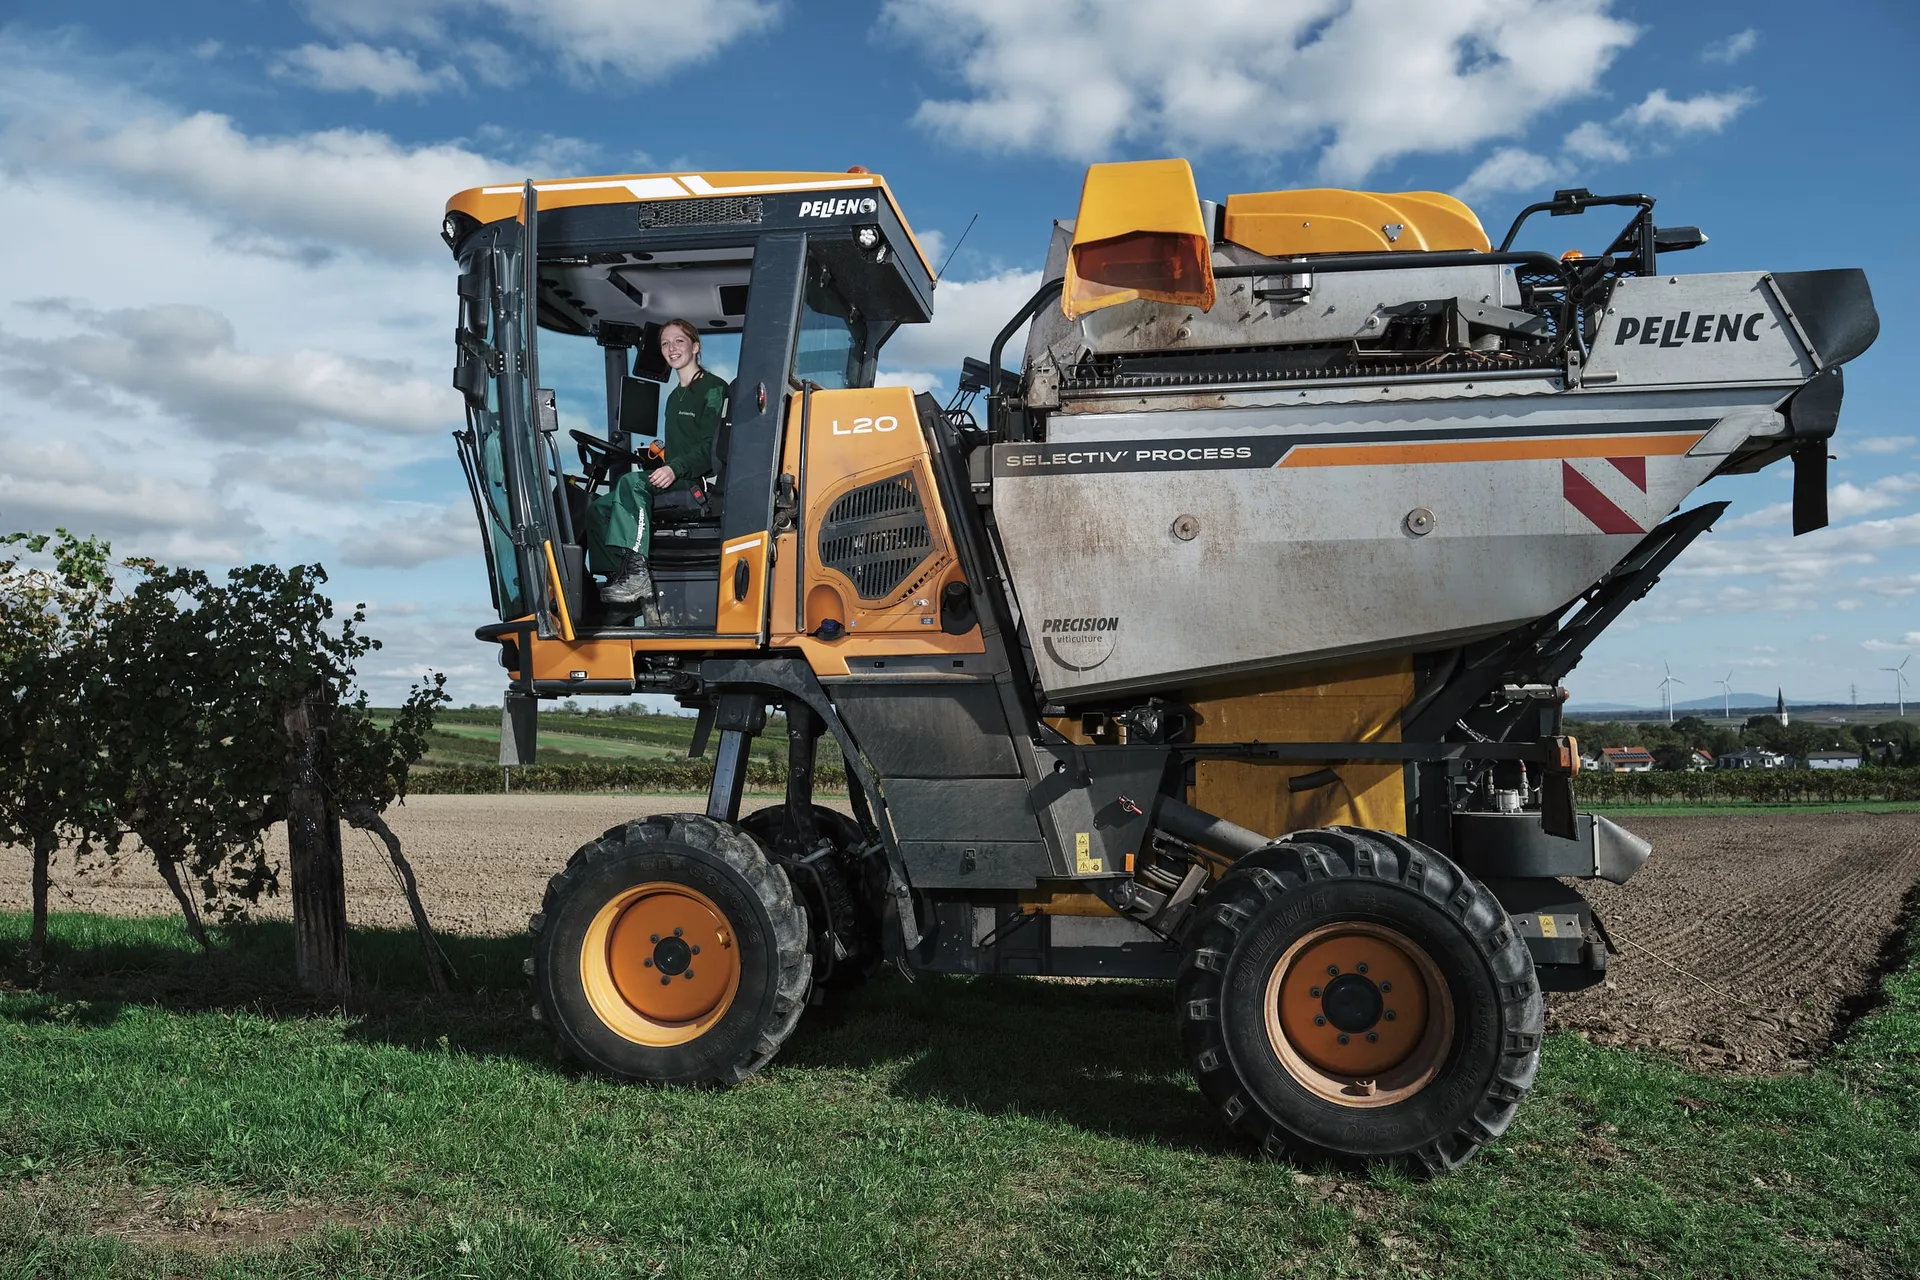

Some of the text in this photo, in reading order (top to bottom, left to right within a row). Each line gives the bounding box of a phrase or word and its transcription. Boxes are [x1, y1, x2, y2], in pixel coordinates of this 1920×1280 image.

[1614, 311, 1765, 348] PELLENC
[832, 415, 898, 436] L20
[1136, 447, 1252, 462] PROCESS
[1042, 617, 1119, 633] PRECISION
[1056, 635, 1103, 644] viticulture
